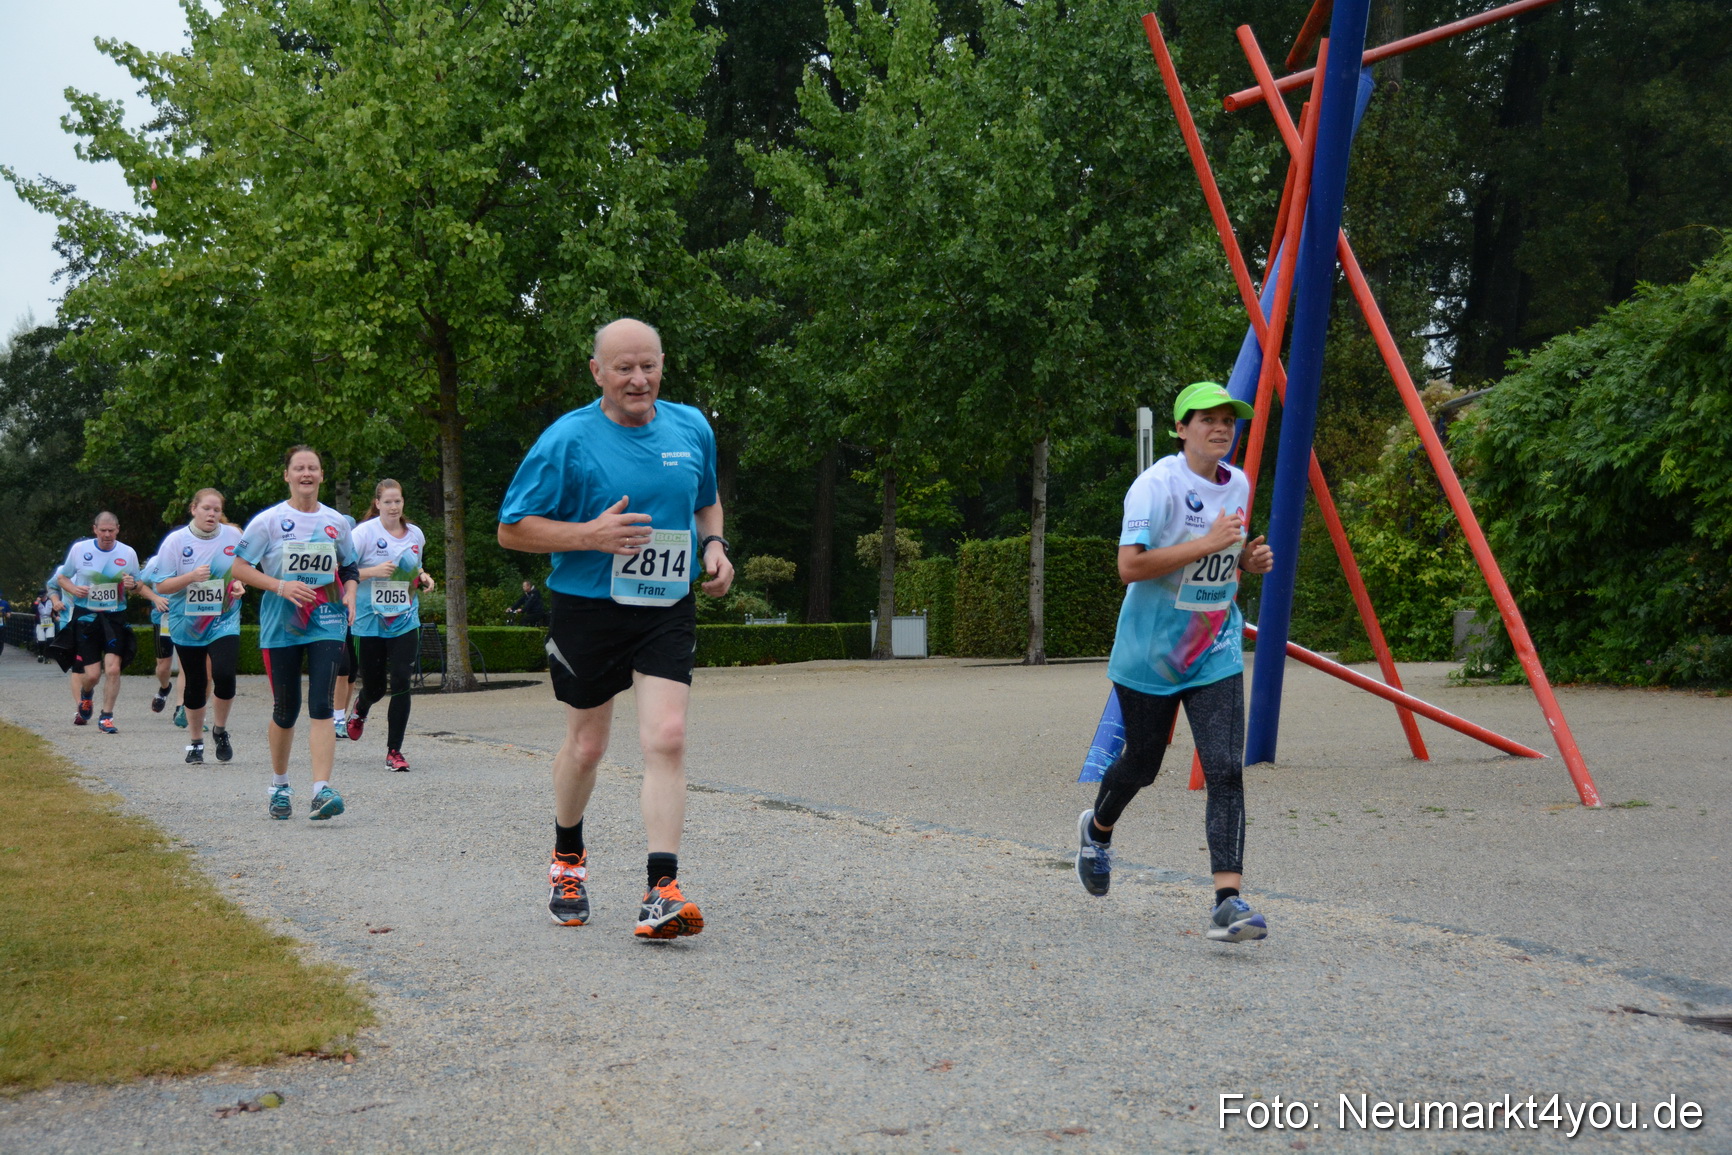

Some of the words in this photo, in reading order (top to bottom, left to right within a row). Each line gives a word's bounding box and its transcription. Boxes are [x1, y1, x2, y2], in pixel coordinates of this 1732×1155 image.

[655, 533, 688, 543] BOCK
[288, 553, 332, 572] 2640
[621, 548, 686, 577] 2814
[297, 575, 318, 585] Peggy
[91, 589, 116, 600] 2380
[189, 589, 222, 602] 2054
[637, 584, 666, 596] Franz
[376, 590, 406, 603] 2055
[319, 605, 331, 614] 17.
